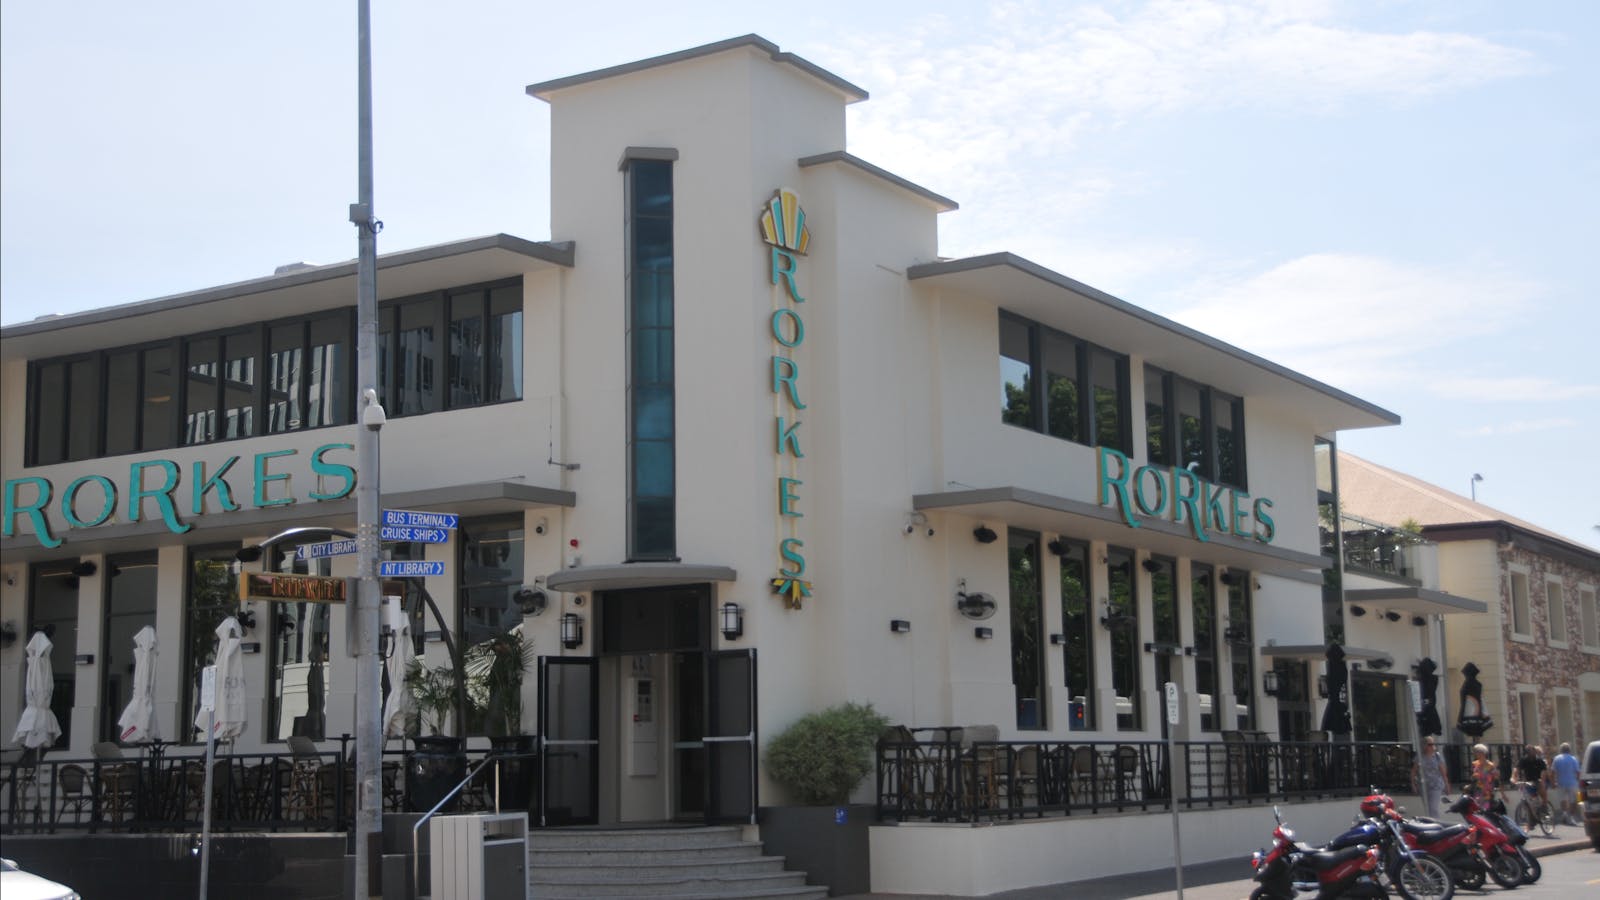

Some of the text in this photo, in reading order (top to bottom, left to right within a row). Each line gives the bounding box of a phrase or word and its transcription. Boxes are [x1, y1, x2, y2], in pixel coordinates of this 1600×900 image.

[769, 247, 806, 577] RORKES
[3, 443, 358, 548] RORKES
[1096, 446, 1275, 543] RORKES
[387, 511, 448, 527] BUS TERMINAL
[381, 527, 439, 542] CRUISE SHIPS
[312, 540, 357, 556] CITY LIBRARY
[385, 562, 435, 575] NT LIBRARY
